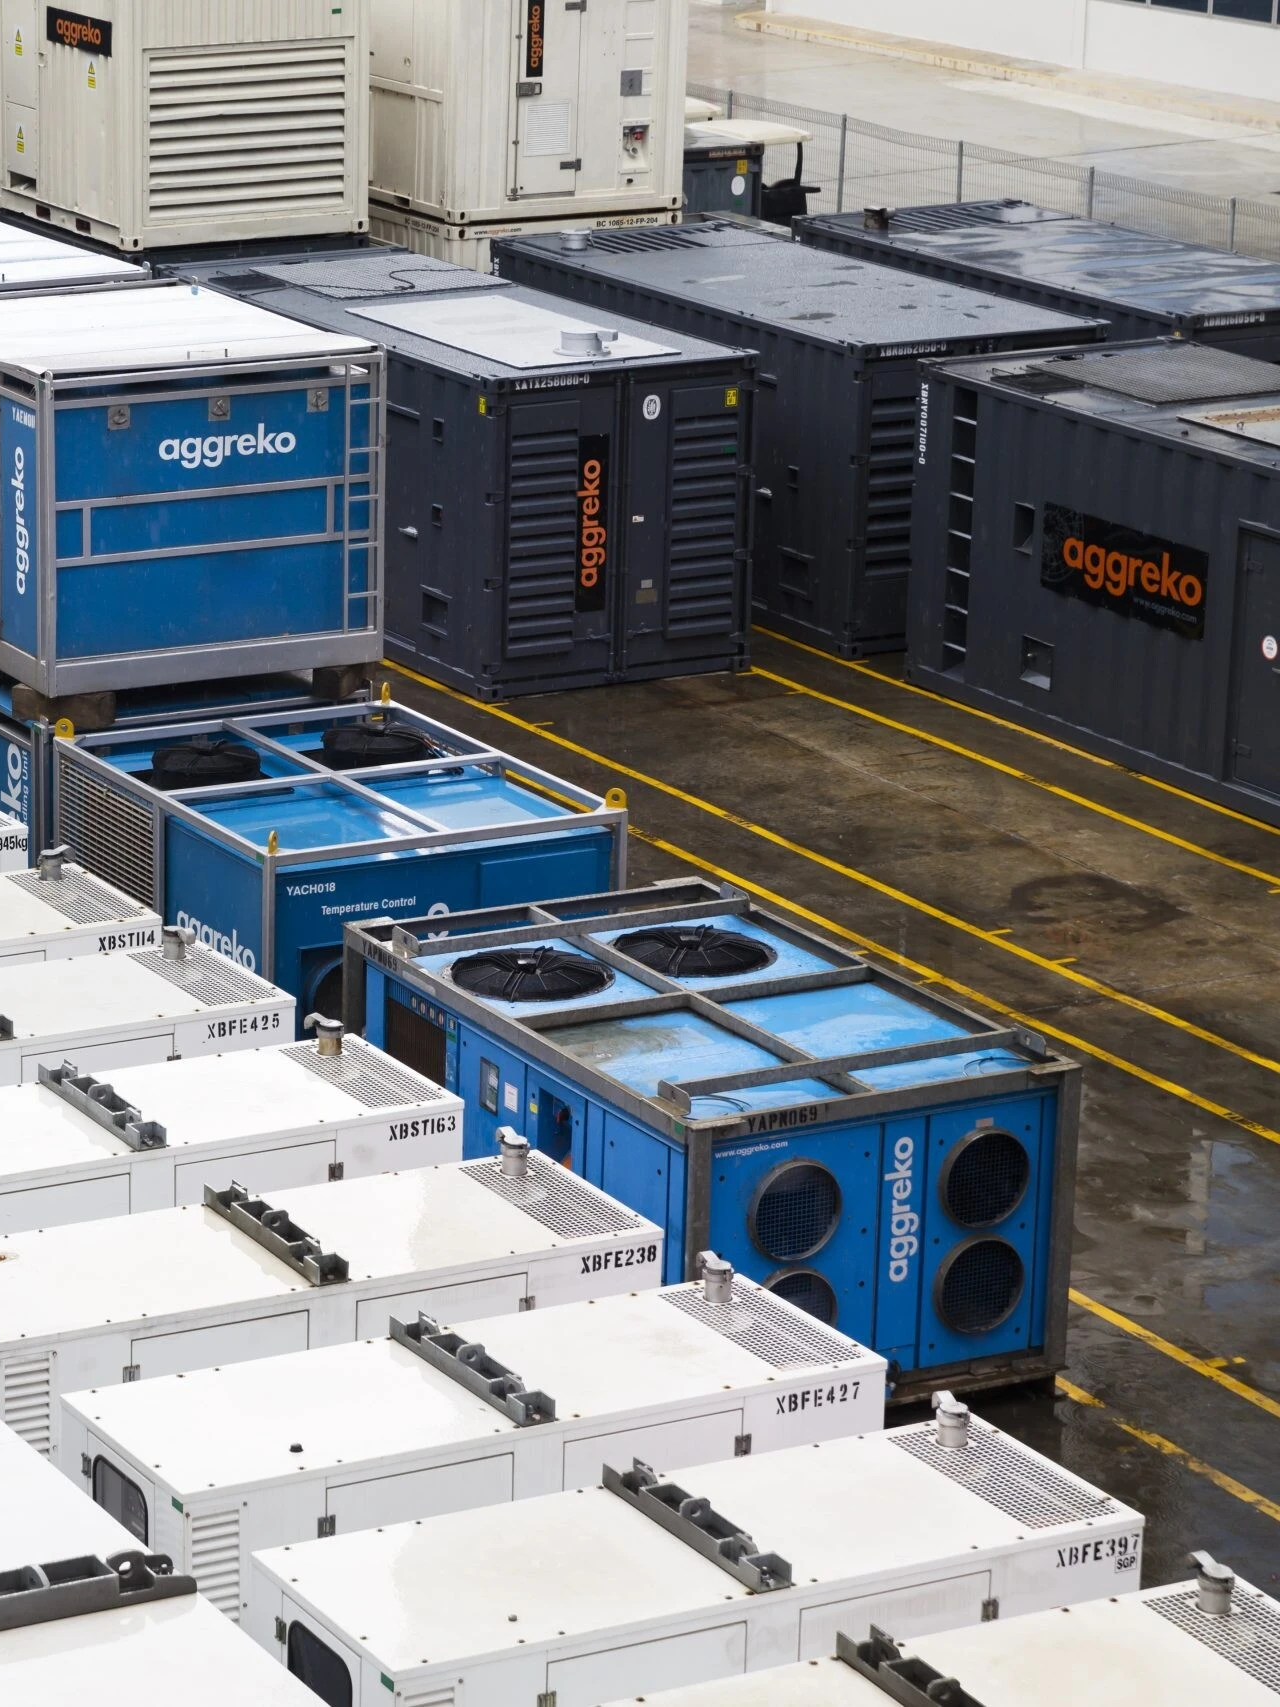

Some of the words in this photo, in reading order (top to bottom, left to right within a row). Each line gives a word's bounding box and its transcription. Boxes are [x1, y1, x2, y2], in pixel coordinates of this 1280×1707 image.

[56, 18, 101, 46] aggreko
[528, 5, 541, 68] aggreko
[596, 220, 606, 228] BC
[159, 422, 297, 469] aggreko
[11, 446, 29, 596] aggreko
[576, 459, 606, 588] aggreko
[1062, 536, 1202, 607] aggreko
[21, 750, 29, 781] Unit
[286, 882, 336, 897] YACH018
[321, 900, 380, 916] Temperature
[381, 895, 417, 909] Control
[98, 930, 155, 952] XBST114
[207, 1013, 280, 1040] XBFE425
[388, 1115, 456, 1141] XBST163
[747, 1105, 818, 1133] YAPN069
[714, 1139, 789, 1159] www.aggreko.com
[884, 1136, 919, 1282] aggreko
[580, 1244, 658, 1274] XBFE238
[776, 1381, 860, 1415] XBFE427
[1056, 1533, 1140, 1568] XBFE397
[1116, 1555, 1136, 1570] SGP
